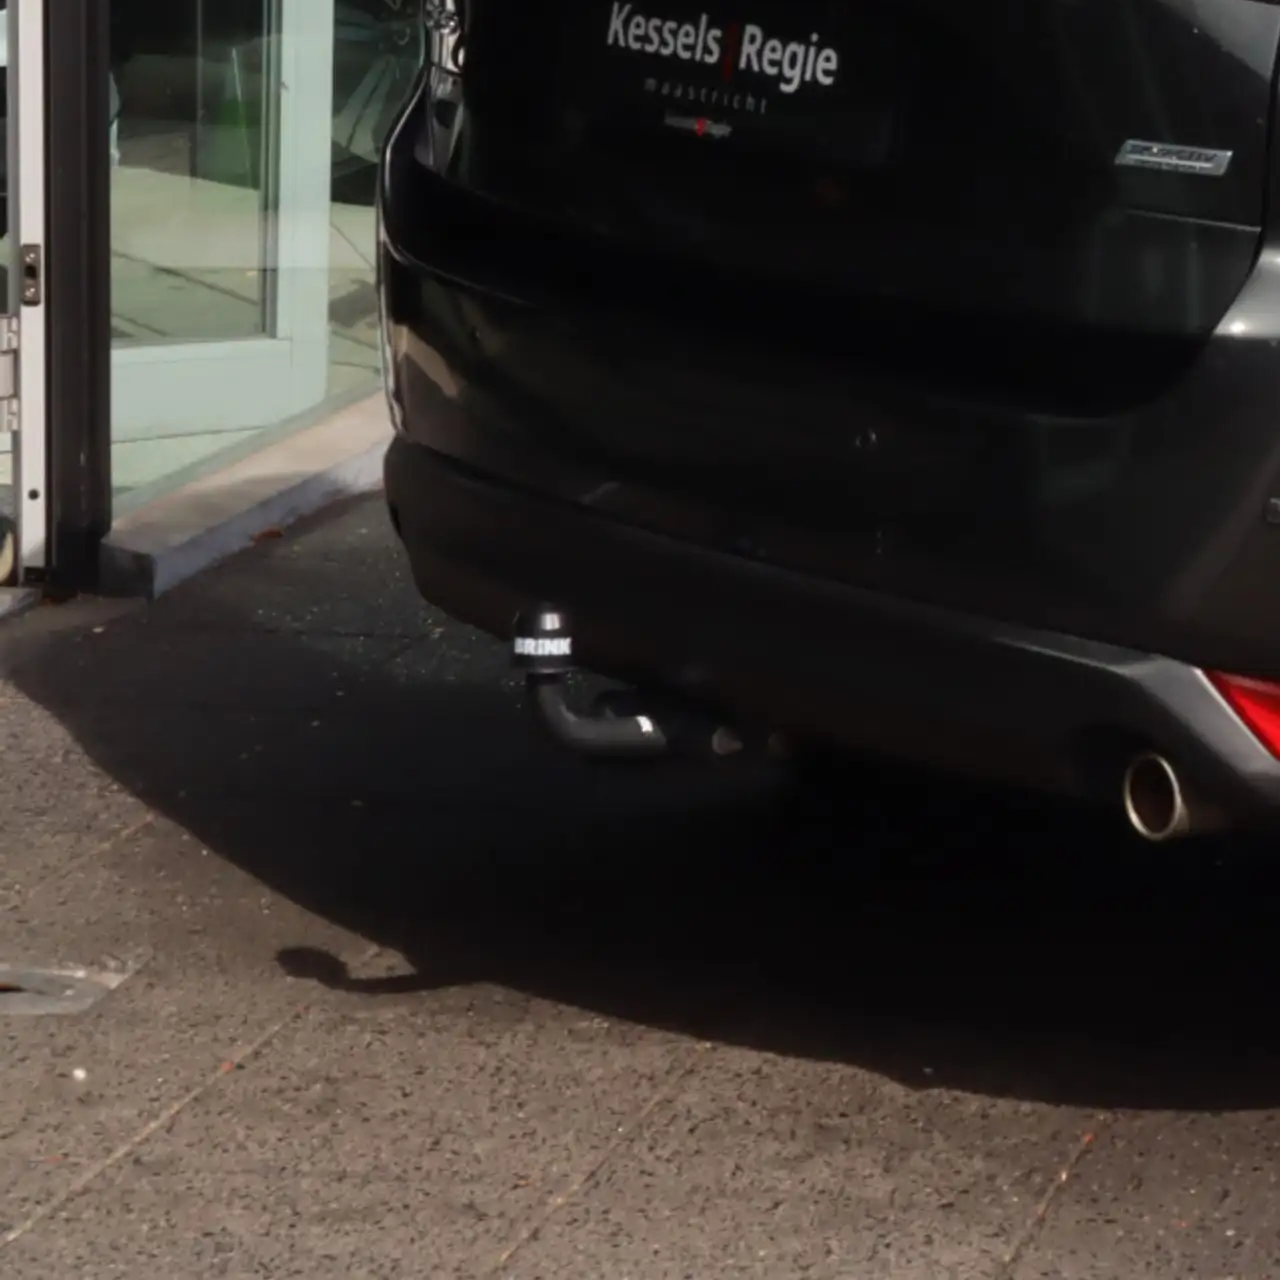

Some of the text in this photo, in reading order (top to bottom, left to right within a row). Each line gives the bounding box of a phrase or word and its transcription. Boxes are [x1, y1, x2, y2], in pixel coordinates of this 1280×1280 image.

[607, 0, 838, 93] Kessels Regie
[514, 636, 571, 655] BRINK
